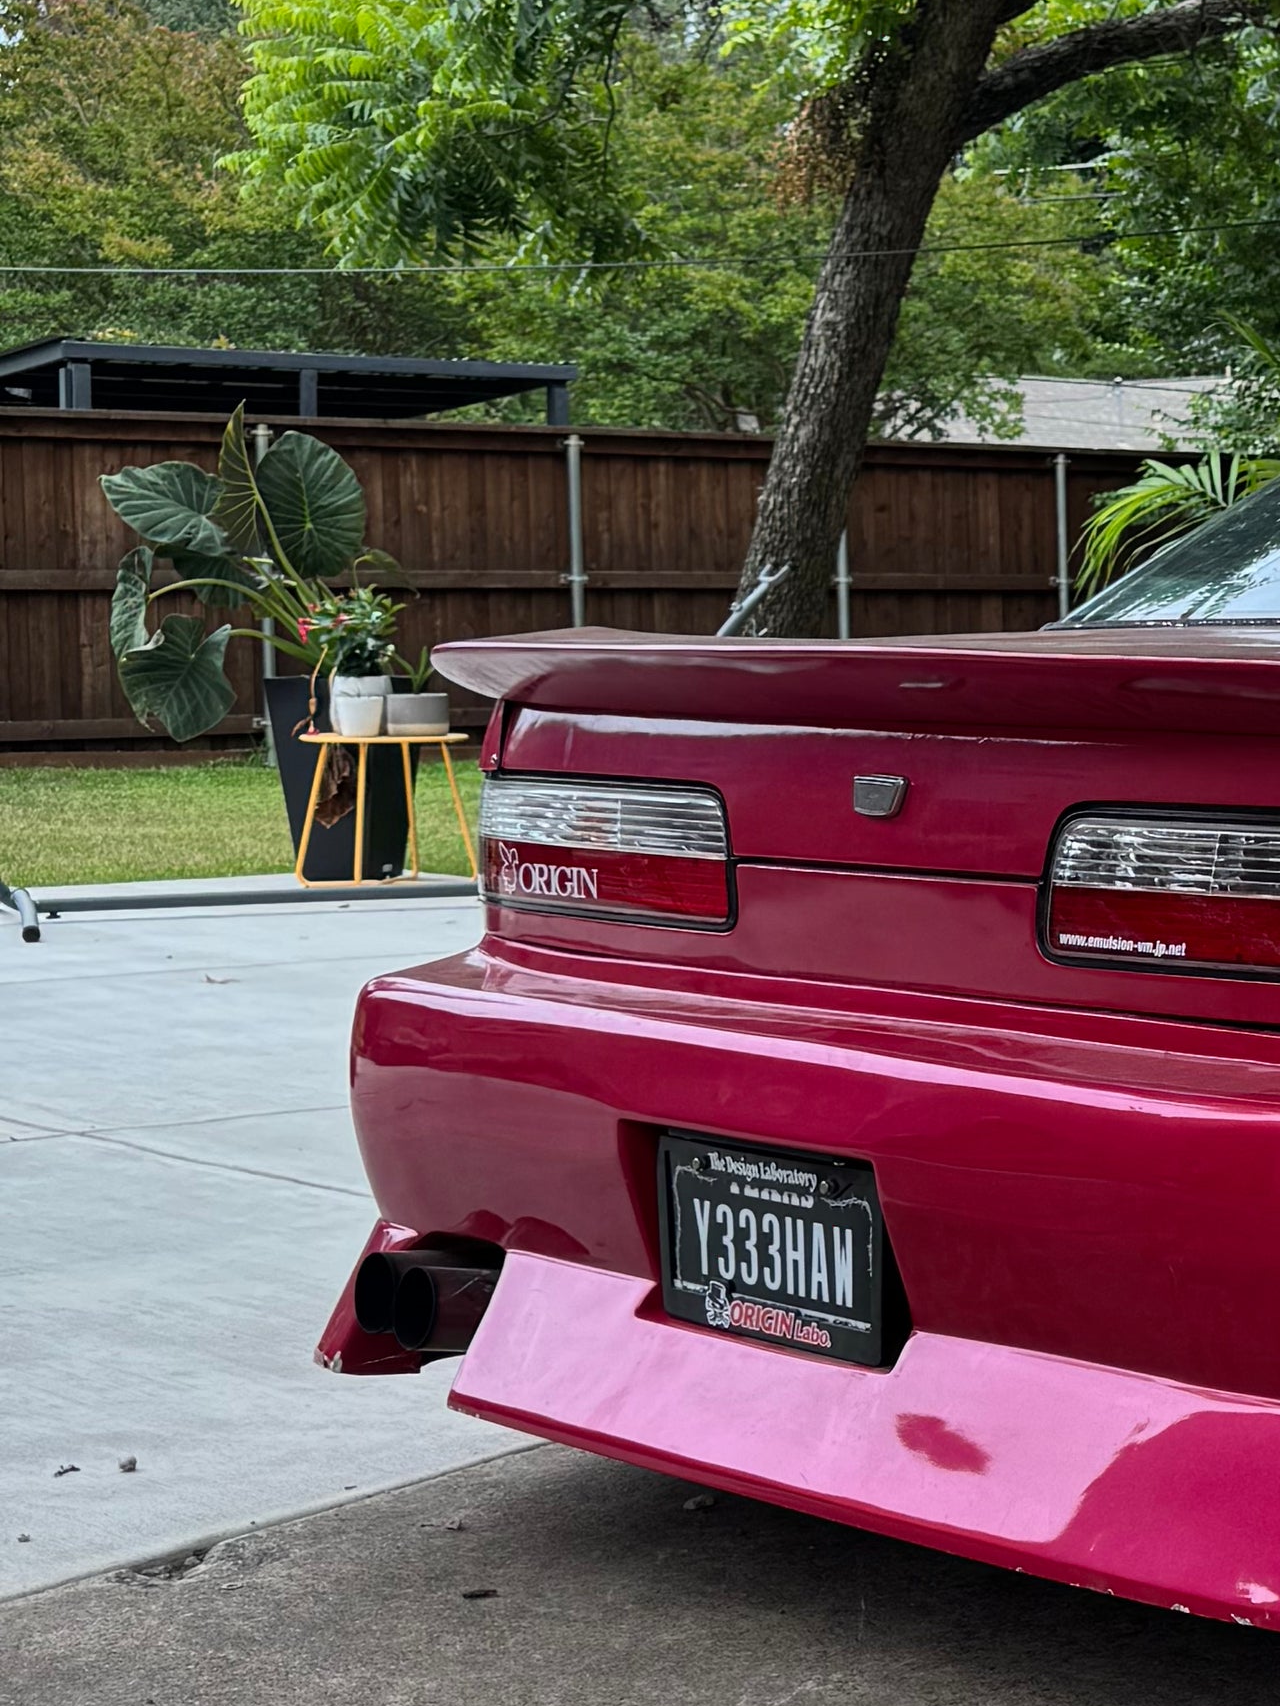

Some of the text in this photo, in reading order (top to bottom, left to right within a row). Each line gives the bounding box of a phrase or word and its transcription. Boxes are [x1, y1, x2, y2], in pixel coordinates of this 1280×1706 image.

[518, 863, 599, 900] ORIGIN
[1059, 933, 1187, 957] www.emulsion-vm.jp.net
[707, 1151, 818, 1193] The Design Laboratory
[692, 1196, 854, 1309] Y333HAW
[729, 1299, 795, 1339] ORIGIN
